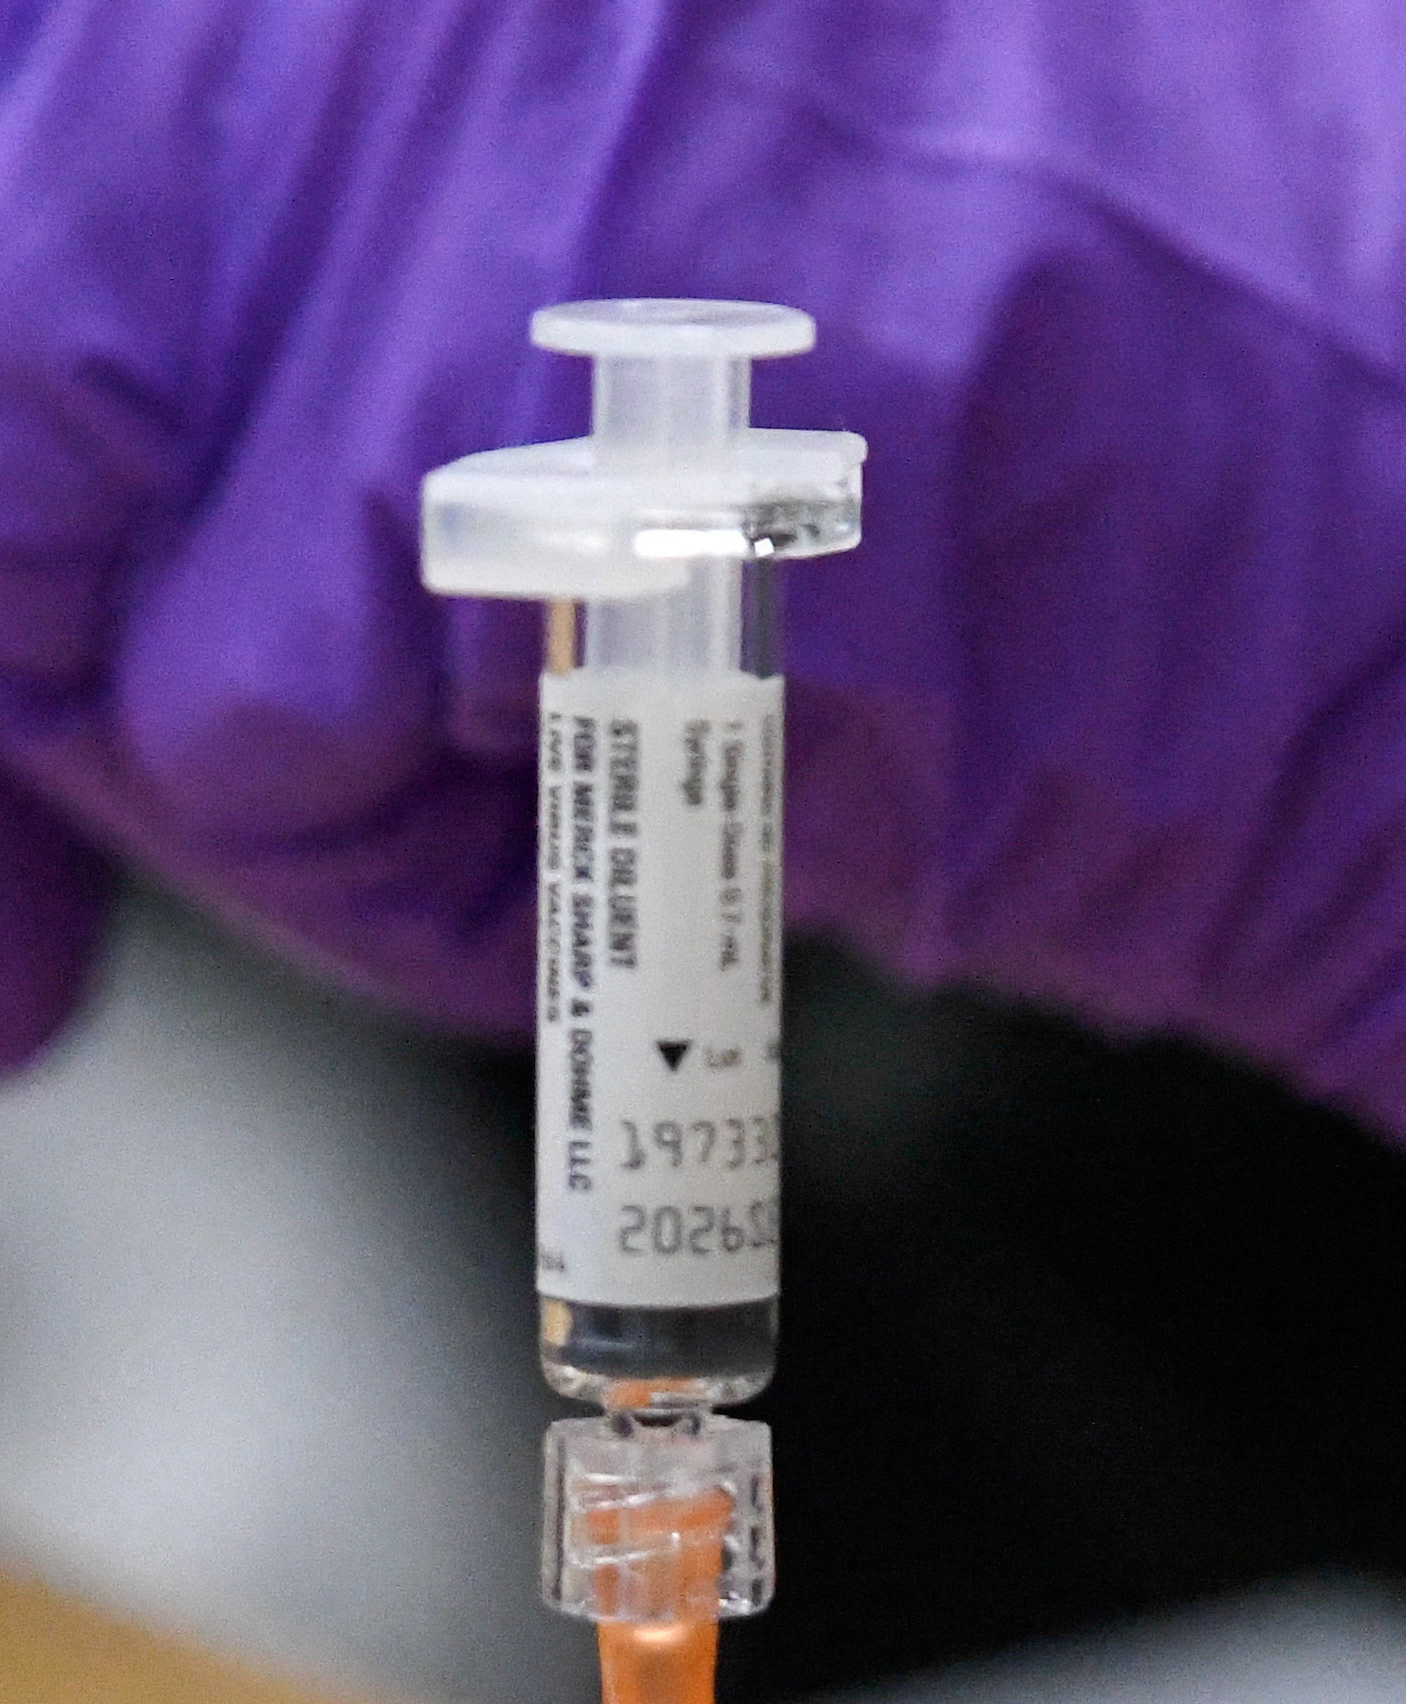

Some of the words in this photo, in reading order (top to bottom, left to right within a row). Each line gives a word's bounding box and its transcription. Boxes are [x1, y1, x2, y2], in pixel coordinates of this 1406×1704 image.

[571, 716, 595, 774] FOR
[608, 720, 639, 839] STERILE
[570, 780, 595, 883] MERCK
[570, 892, 595, 988] SHARP
[607, 846, 639, 969] DILUENT
[568, 1140, 594, 1192] LLC
